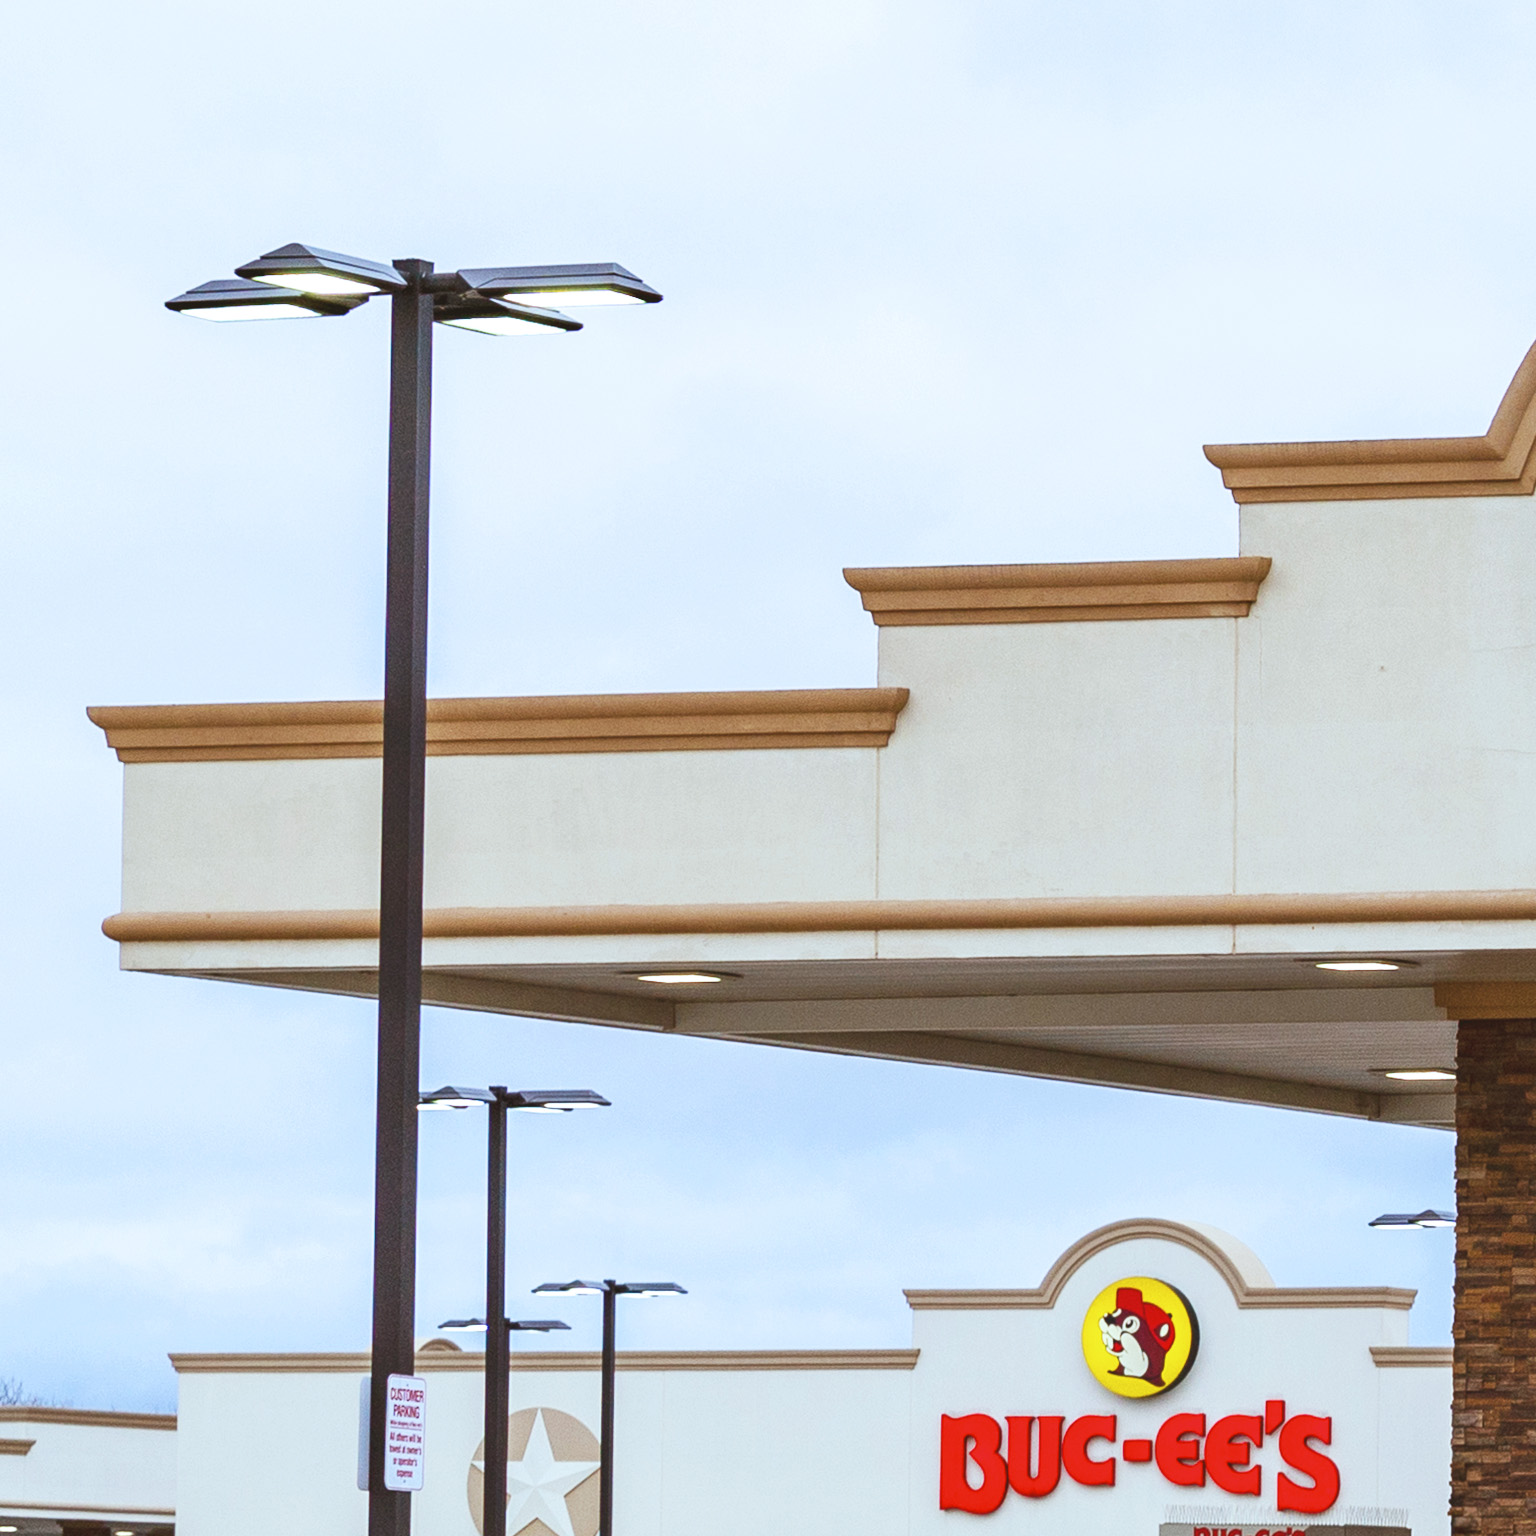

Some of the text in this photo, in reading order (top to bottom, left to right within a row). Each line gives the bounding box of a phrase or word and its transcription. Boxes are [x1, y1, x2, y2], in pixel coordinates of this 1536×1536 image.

[390, 1387, 424, 1403] CUSTOMER
[393, 1404, 420, 1419] PARKING
[939, 1400, 1341, 1515] BUC-EE'S
